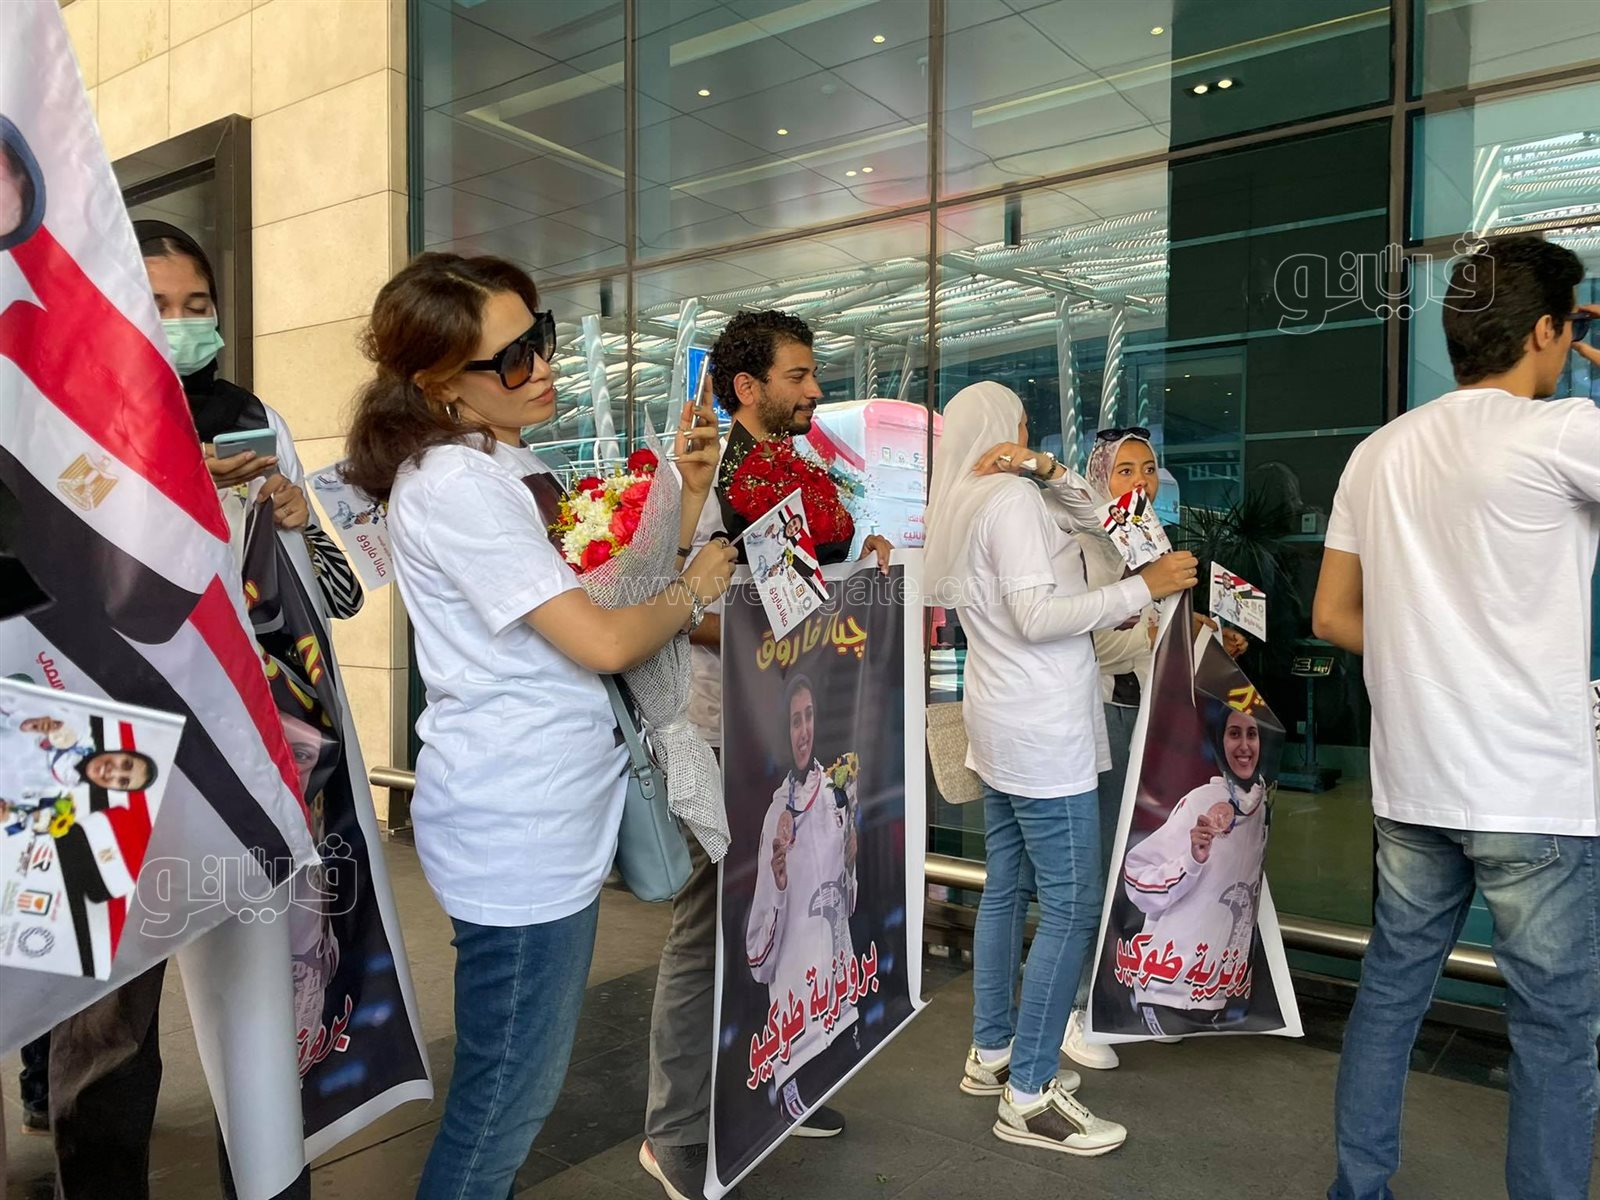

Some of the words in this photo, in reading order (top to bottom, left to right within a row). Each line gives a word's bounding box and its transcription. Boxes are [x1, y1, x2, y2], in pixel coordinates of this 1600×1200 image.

[808, 940, 880, 1031] برونزية
[1114, 933, 1184, 988] طوكيو
[746, 988, 806, 1090] طوكيو
